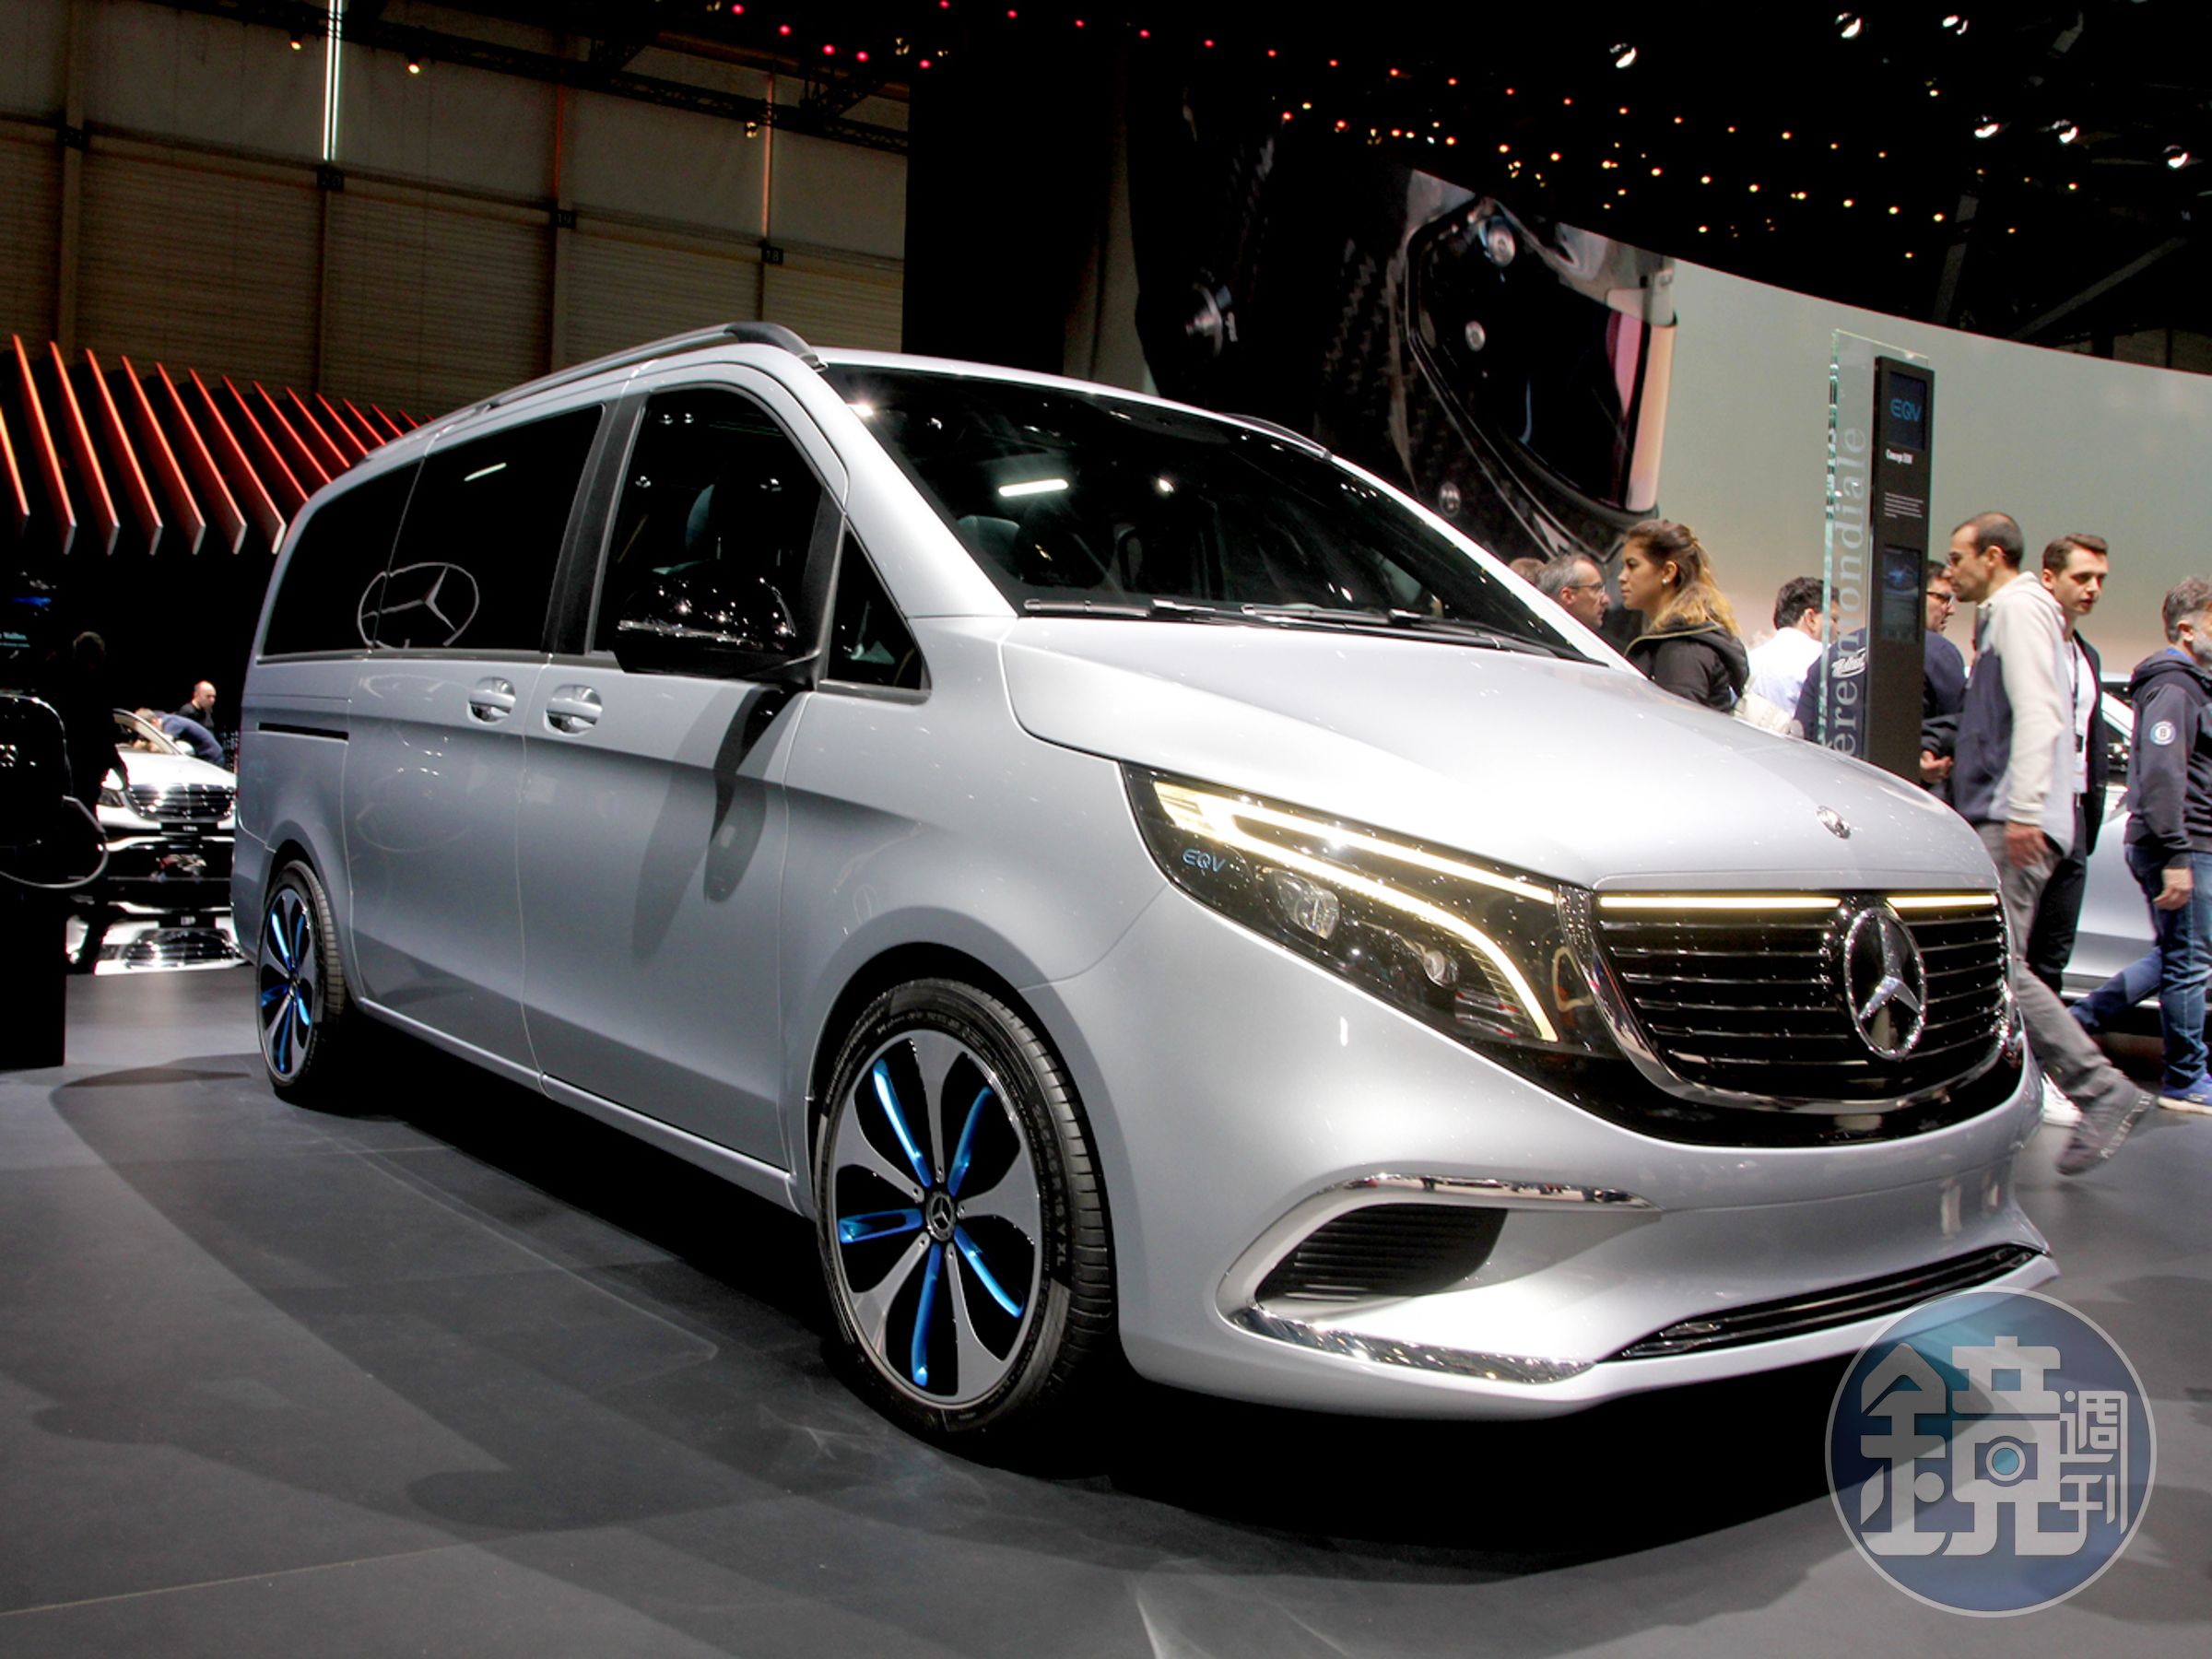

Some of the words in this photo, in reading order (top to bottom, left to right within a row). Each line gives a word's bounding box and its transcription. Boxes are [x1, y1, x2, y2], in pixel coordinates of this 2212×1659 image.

[1890, 398, 1923, 422] EQV
[1835, 427, 1866, 660] mondiale
[1182, 848, 1226, 873] EQV
